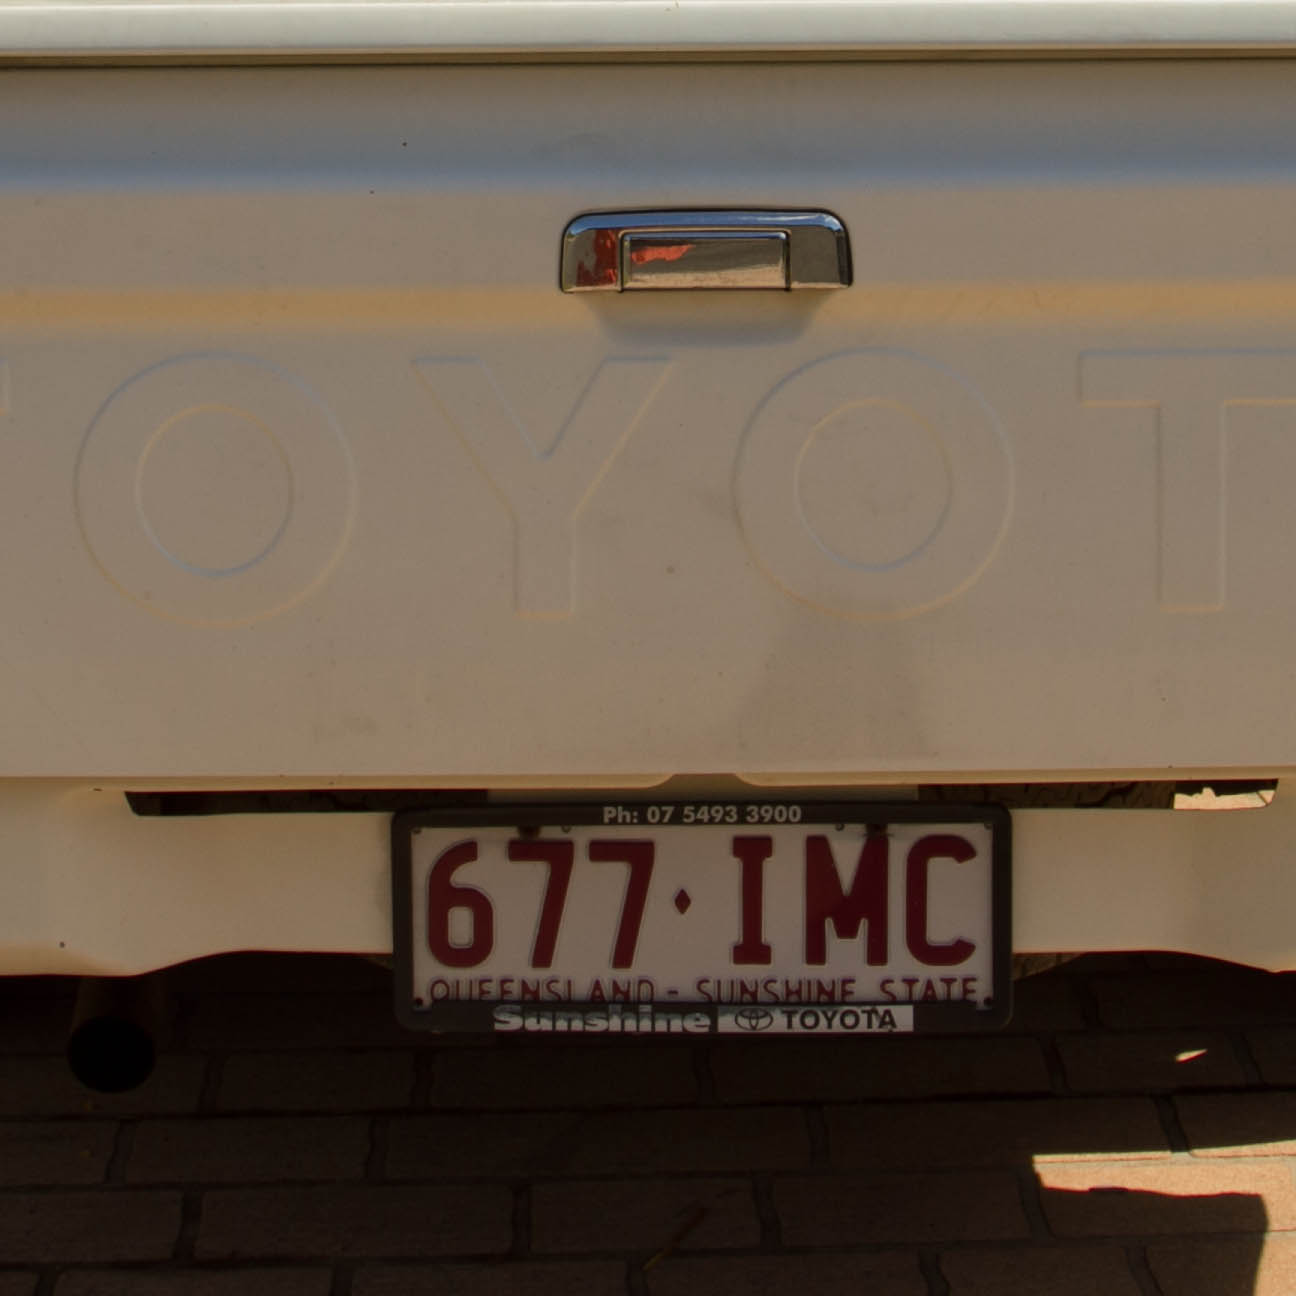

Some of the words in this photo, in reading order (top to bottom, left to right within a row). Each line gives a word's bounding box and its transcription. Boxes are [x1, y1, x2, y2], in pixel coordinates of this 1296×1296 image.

[603, 806, 639, 823] Ph:
[646, 806, 675, 823] 07
[682, 806, 738, 823] 5493
[745, 806, 802, 823] 3900
[696, 978, 856, 1003] SUNSHINE
[879, 977, 977, 1002] STATE
[492, 1003, 711, 1033] Sunshine
[781, 1009, 897, 1031] TOYOTA
